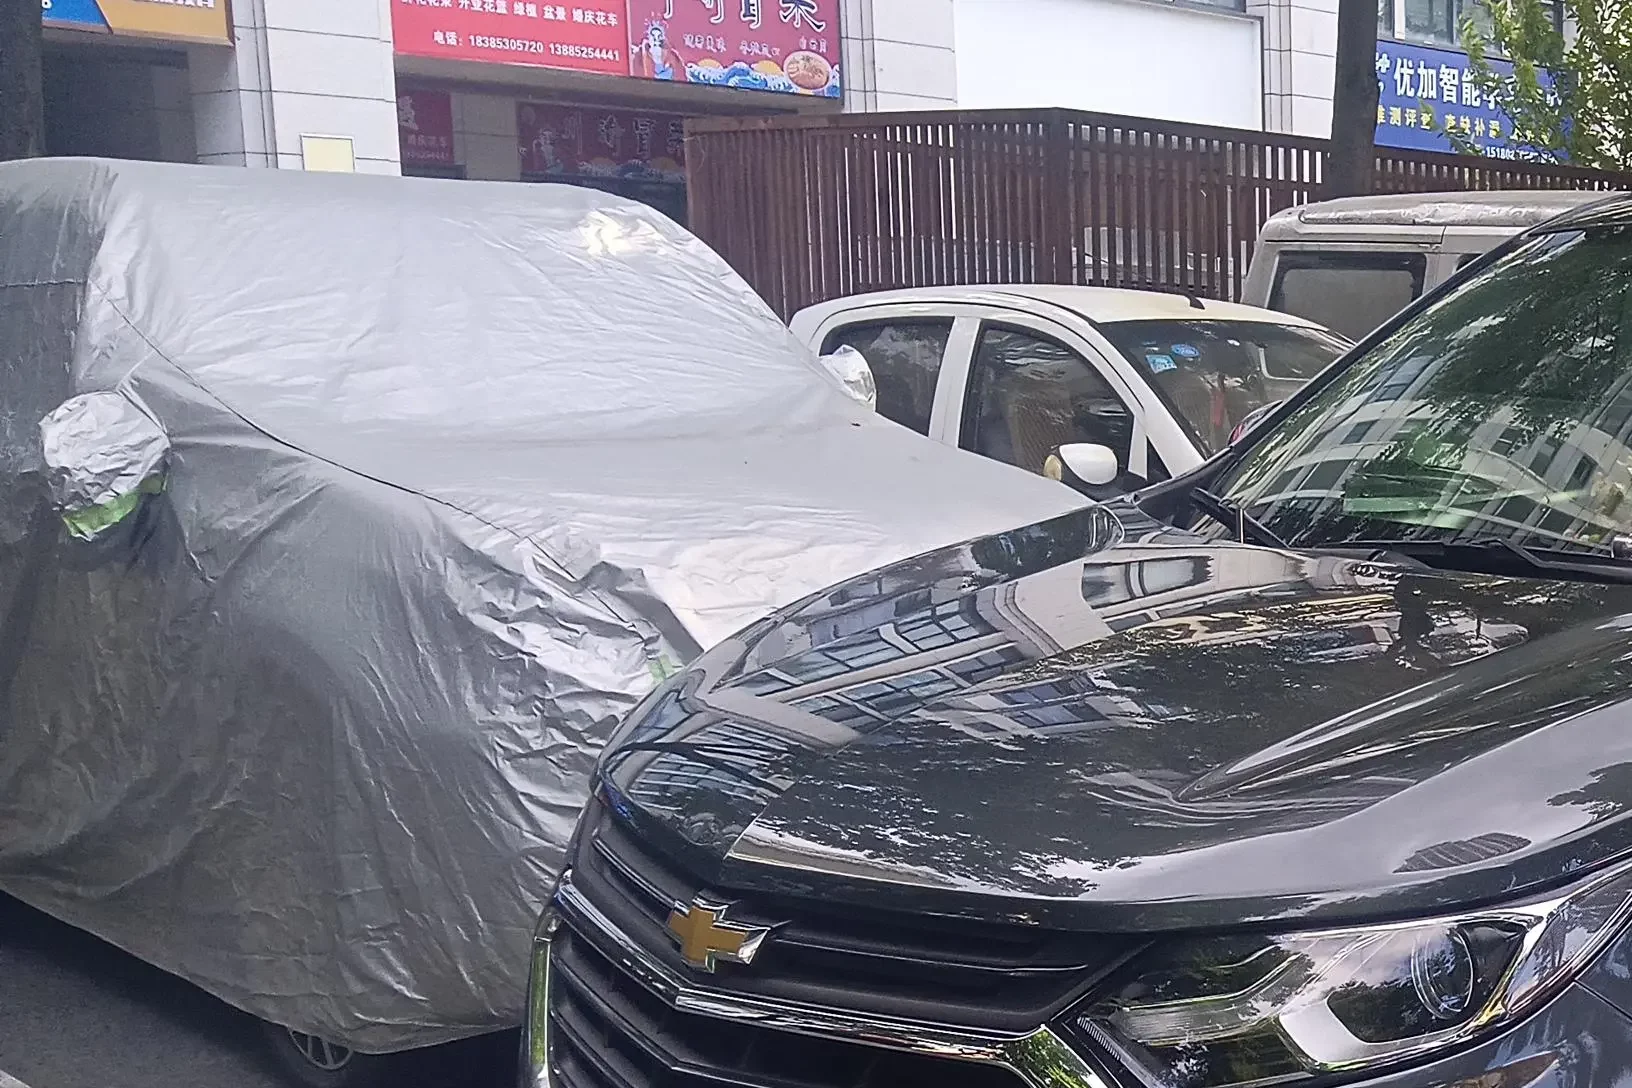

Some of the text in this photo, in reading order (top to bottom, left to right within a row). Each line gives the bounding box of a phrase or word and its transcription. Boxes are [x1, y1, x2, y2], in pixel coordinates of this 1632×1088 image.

[572, 9, 618, 26] 婚庆花车
[469, 35, 544, 53] 18385305720
[549, 43, 620, 61] 13885254441
